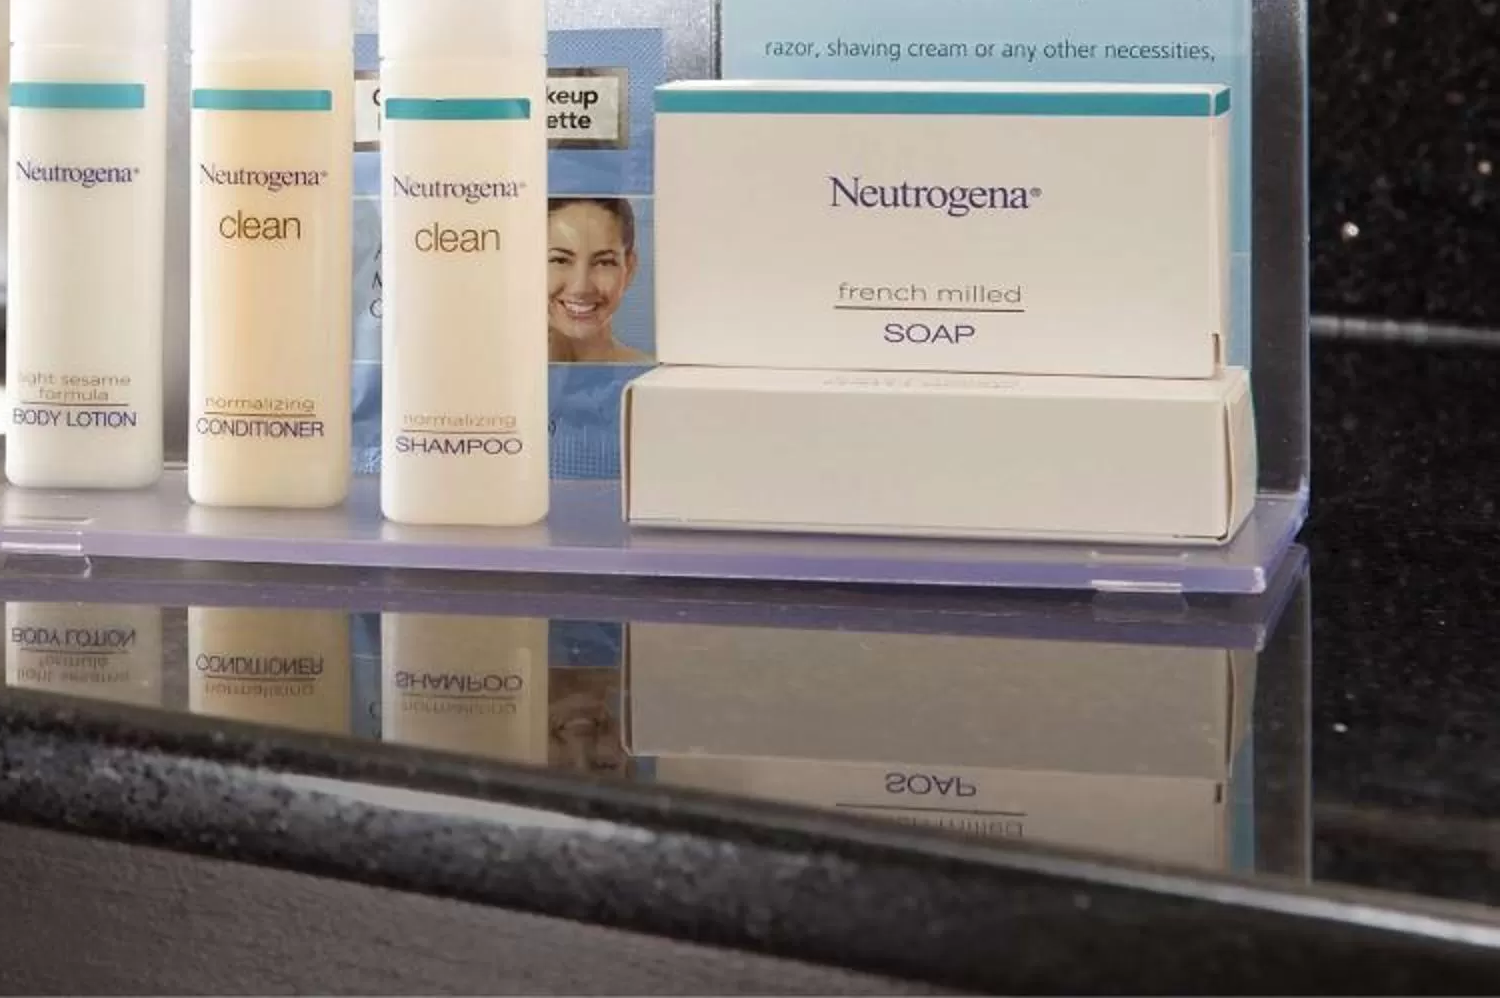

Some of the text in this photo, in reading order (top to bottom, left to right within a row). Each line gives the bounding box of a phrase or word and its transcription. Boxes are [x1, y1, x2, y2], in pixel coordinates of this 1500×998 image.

[765, 38, 1216, 63] razor, shaving cream or any other necessities,
[546, 85, 599, 110] keup
[546, 111, 592, 129] ette
[219, 209, 301, 240] clean
[415, 222, 501, 252] clean
[838, 282, 1022, 304] french milled
[883, 322, 976, 344] SOAP
[60, 373, 131, 387] sesame
[39, 387, 109, 401] formula
[204, 396, 315, 413] normalizing
[12, 407, 137, 428] BODY LOTION
[196, 417, 324, 438] CONDITIONER
[403, 412, 517, 428] normalizing
[395, 435, 523, 455] SHAMPOO
